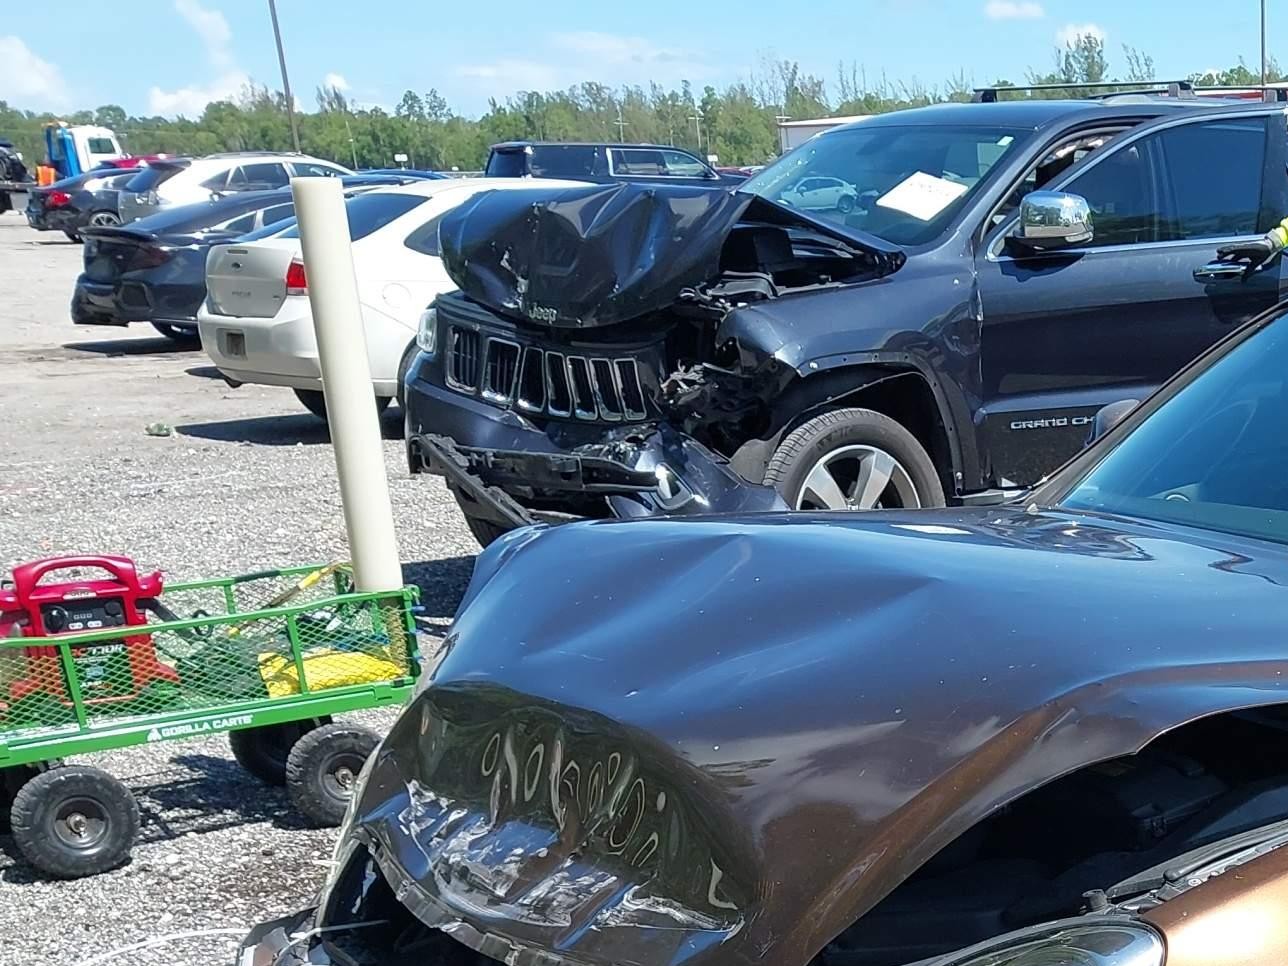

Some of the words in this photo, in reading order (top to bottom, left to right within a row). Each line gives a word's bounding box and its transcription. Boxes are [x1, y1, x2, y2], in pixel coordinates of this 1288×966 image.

[529, 303, 558, 325] Jeep
[1011, 418, 1068, 430] GRAND
[161, 722, 212, 738] GORILLA
